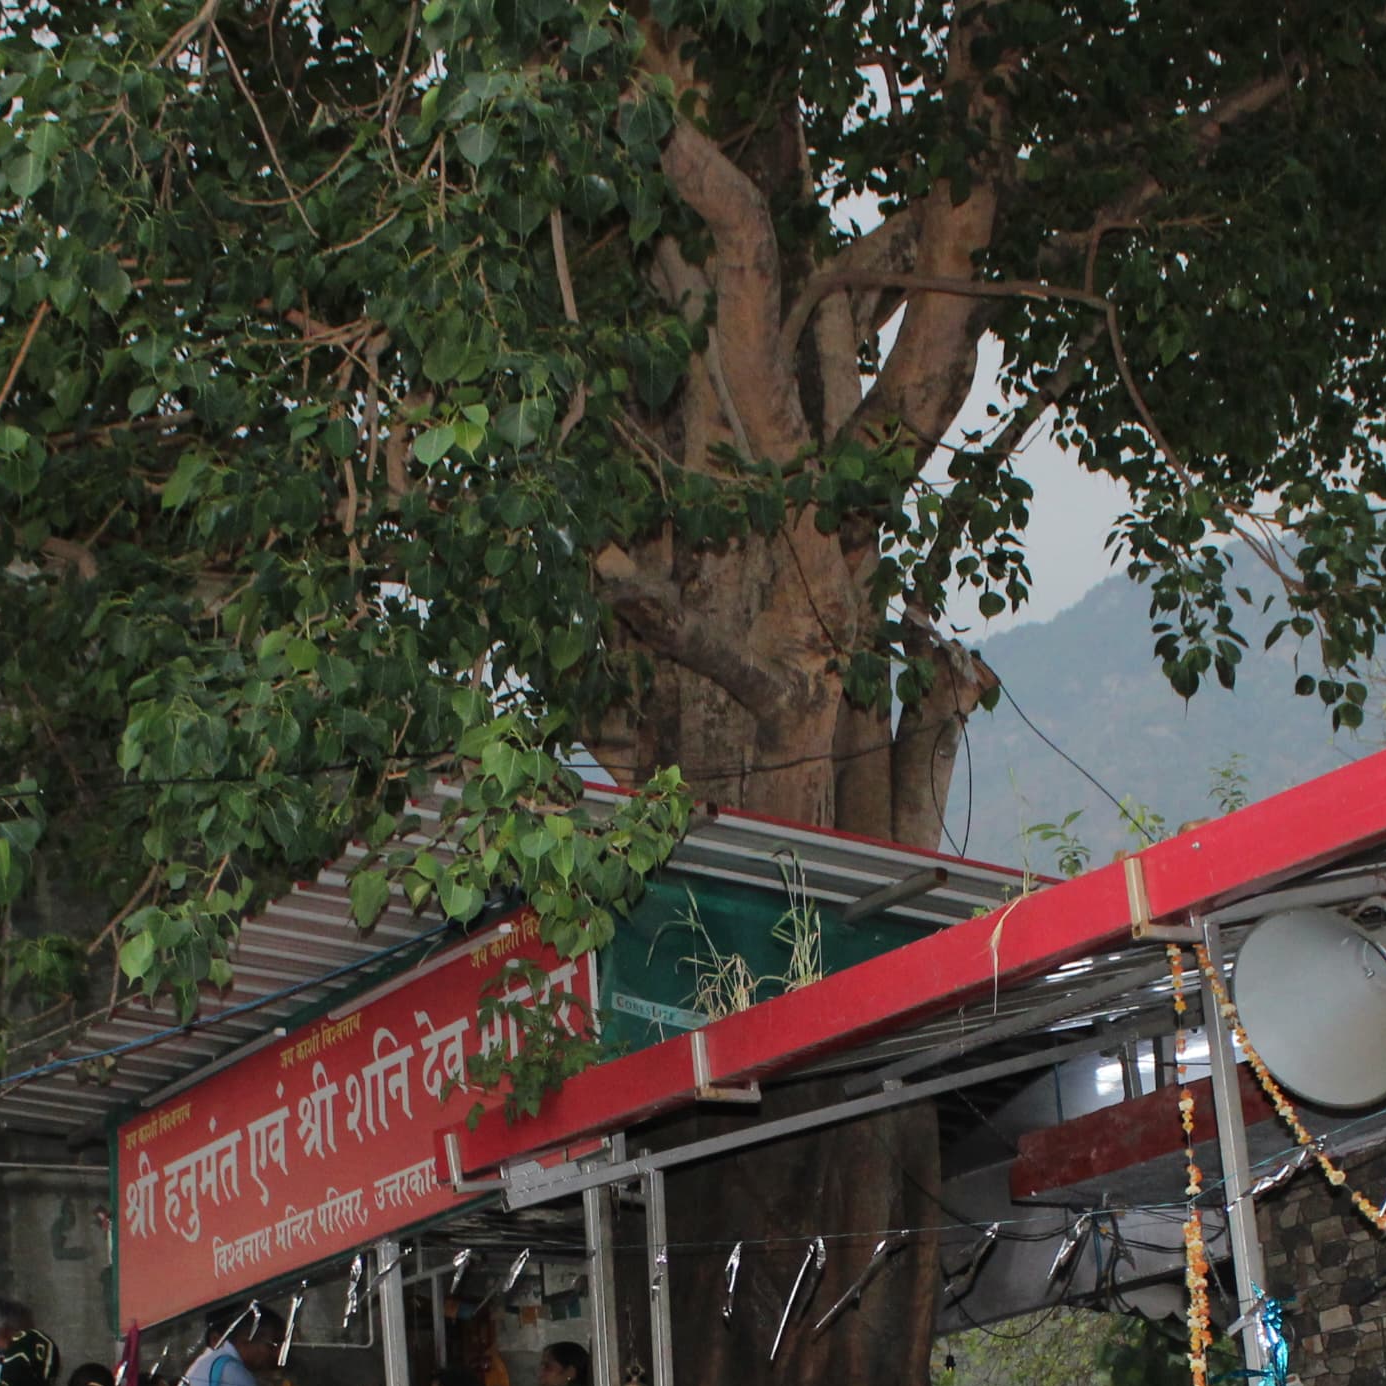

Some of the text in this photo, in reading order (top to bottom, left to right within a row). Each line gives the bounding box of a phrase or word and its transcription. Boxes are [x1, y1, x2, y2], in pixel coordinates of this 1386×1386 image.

[126, 1151, 159, 1239] श्री
[164, 1116, 243, 1242] हनुमंत
[247, 1081, 290, 1206] एवं
[297, 1061, 339, 1160] श्री
[346, 1027, 414, 1143] शनि
[414, 1010, 471, 1104] देव
[213, 1236, 272, 1279] विश्वनाथ
[275, 1205, 316, 1251] मन्दिर
[318, 1187, 369, 1237] परिसर,
